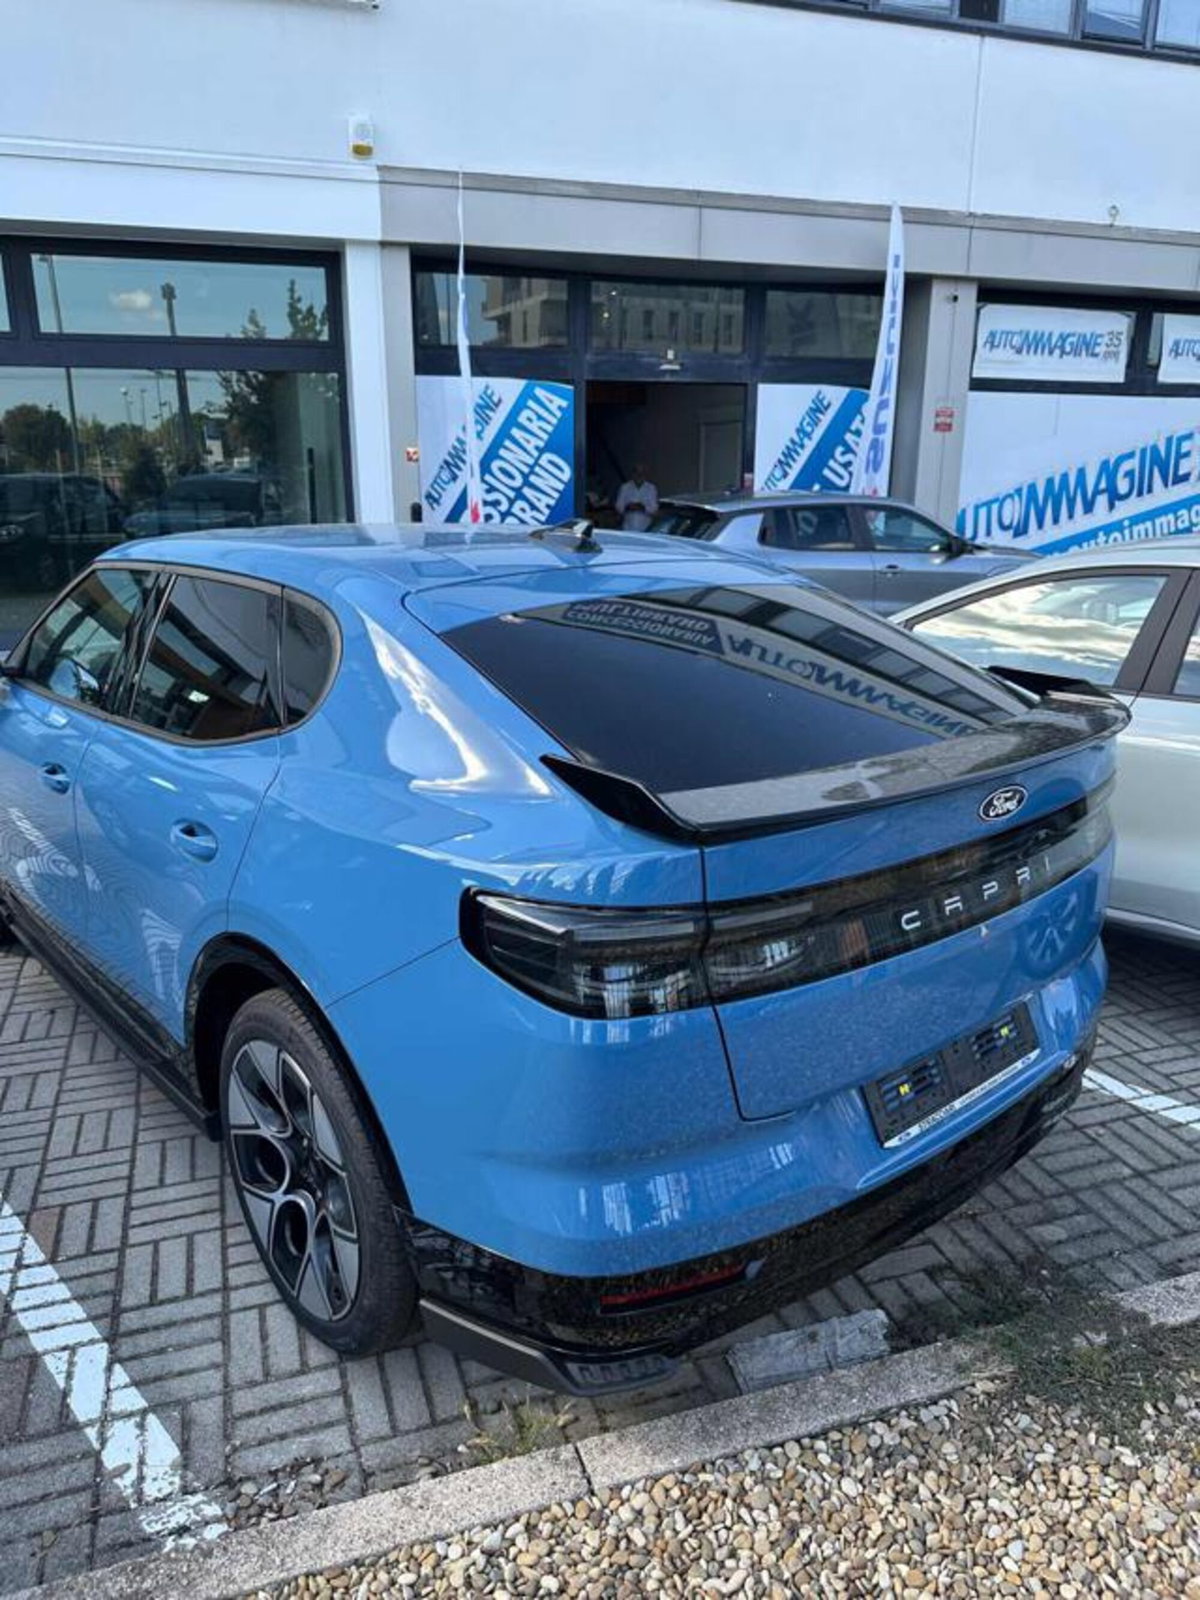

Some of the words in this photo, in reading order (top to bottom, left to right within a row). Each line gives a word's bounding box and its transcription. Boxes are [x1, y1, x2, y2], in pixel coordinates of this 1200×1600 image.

[983, 329, 1104, 359] AUTOIMMAGINE
[1105, 330, 1124, 348] 35
[1168, 338, 1200, 362] AUTO
[901, 856, 1050, 930] CAPRI
